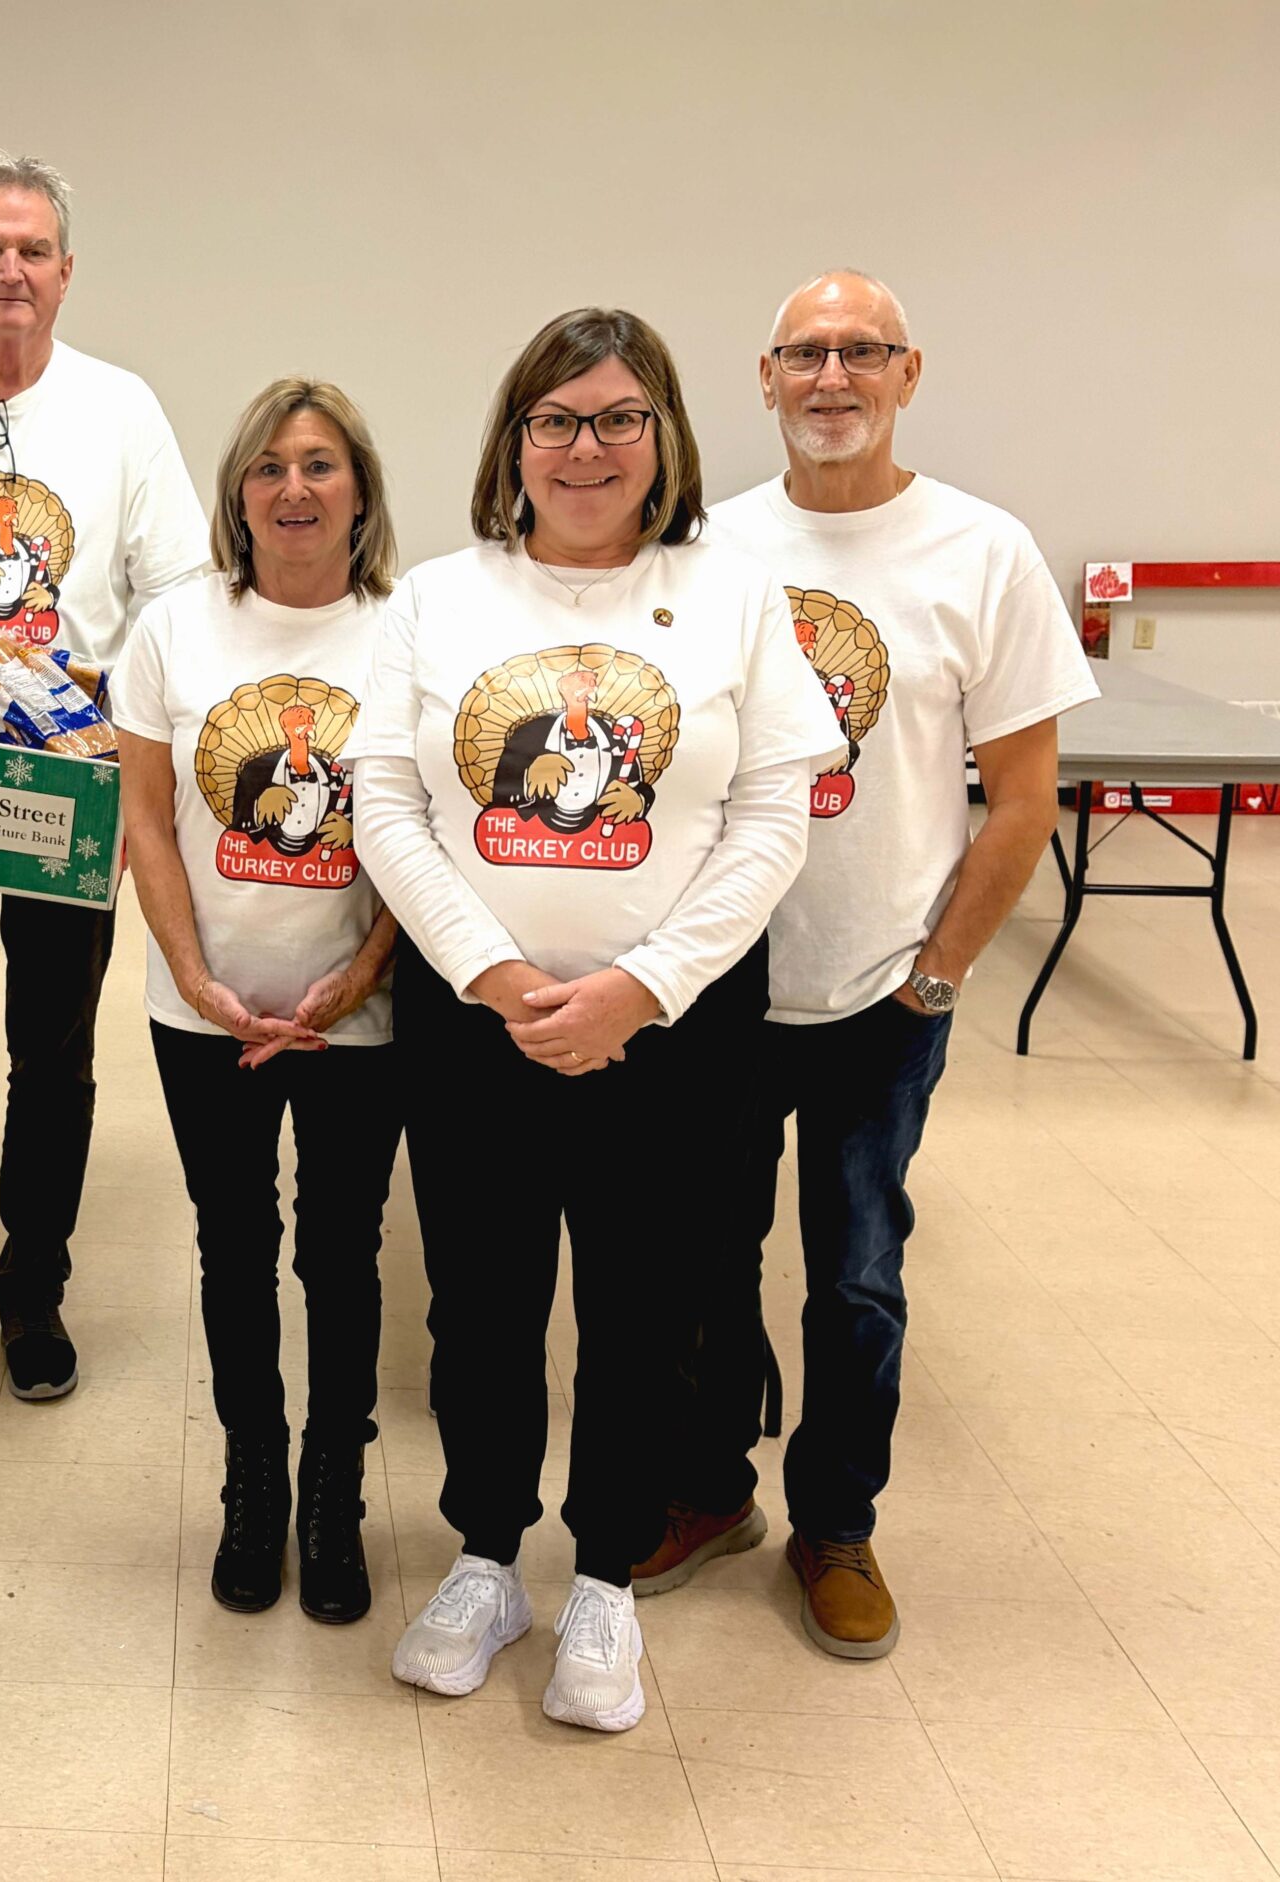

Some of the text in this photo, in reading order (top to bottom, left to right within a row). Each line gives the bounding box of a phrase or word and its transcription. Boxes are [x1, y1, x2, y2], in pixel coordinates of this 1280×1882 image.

[814, 792, 841, 811] UB
[485, 817, 516, 833] THE
[31, 831, 67, 847] Bank
[224, 836, 247, 853] THE
[486, 838, 639, 862] TURKEY CLUB
[222, 854, 352, 882] TURKEY CLUB
